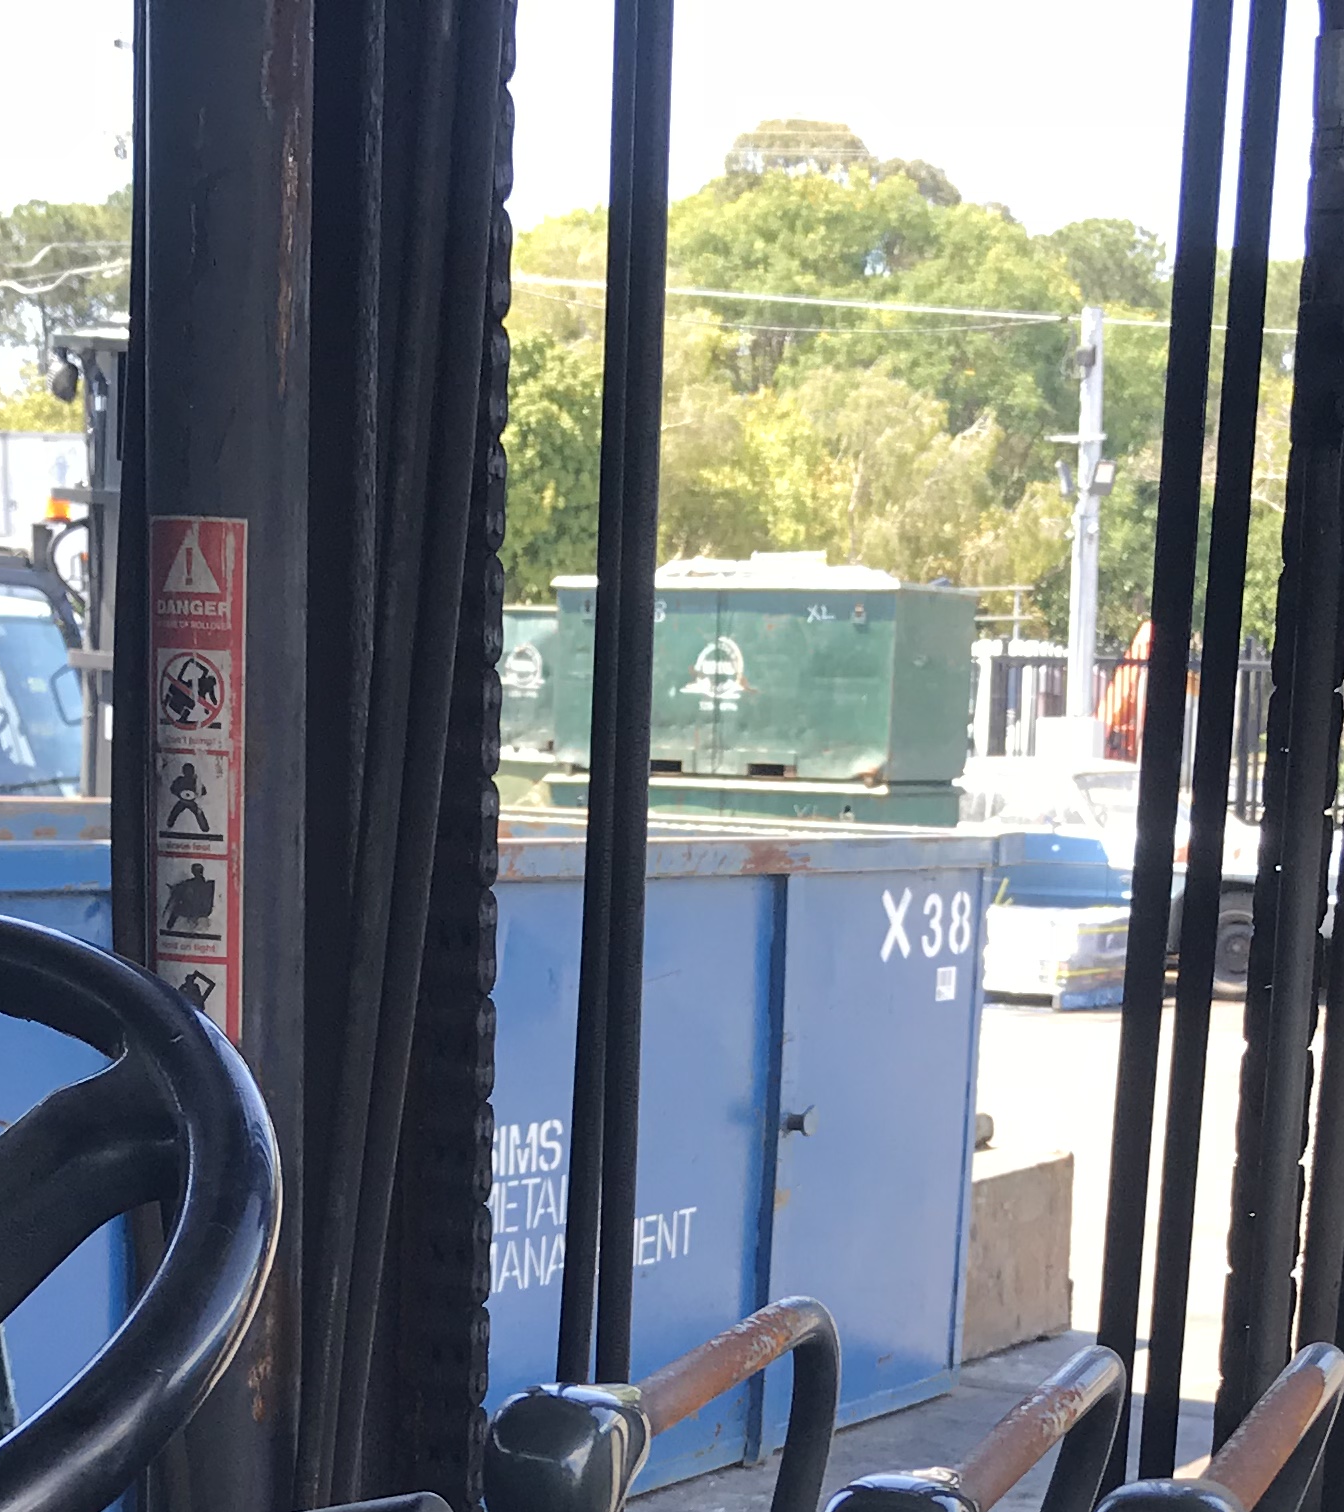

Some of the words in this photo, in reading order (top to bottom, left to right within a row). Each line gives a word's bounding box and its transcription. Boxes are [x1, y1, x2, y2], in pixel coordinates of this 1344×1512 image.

[157, 599, 232, 617] DANGER
[806, 604, 836, 623] XL
[879, 886, 914, 963] X
[921, 890, 971, 959] 38
